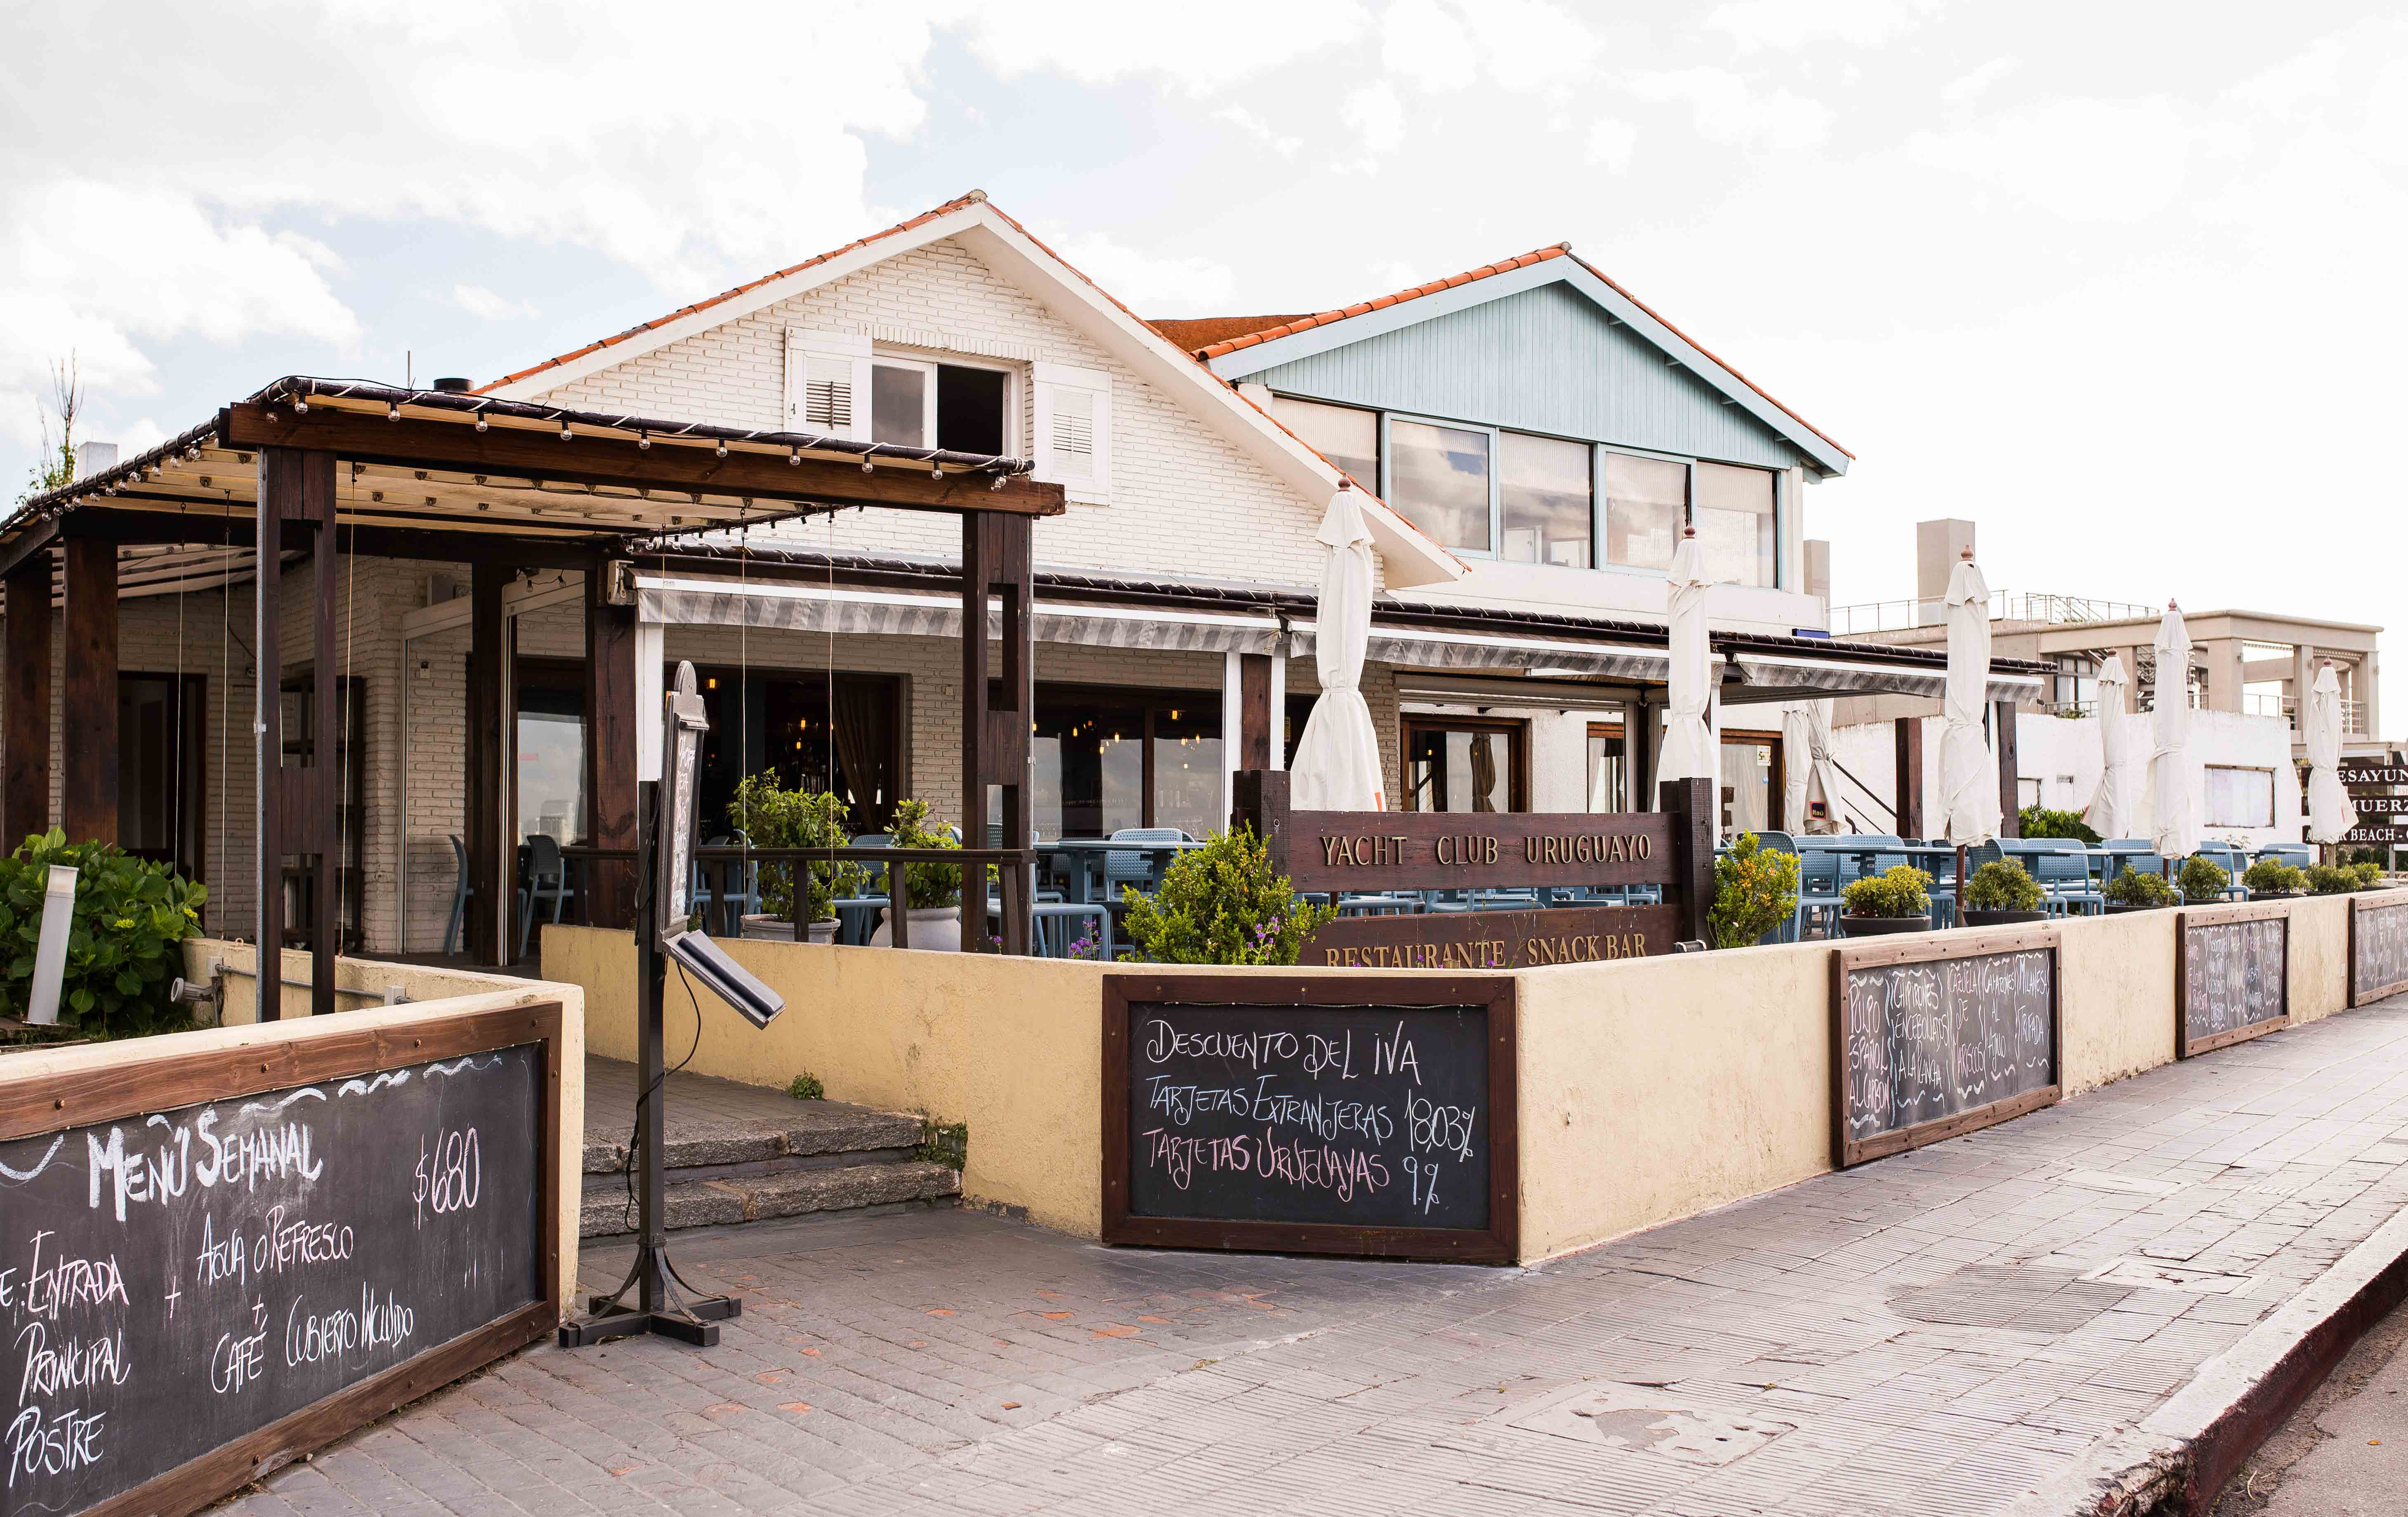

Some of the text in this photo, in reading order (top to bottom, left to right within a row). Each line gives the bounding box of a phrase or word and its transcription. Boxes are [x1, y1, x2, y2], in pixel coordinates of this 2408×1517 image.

[2337, 769, 2408, 782] ESAYUN
[1320, 833, 1652, 866] YACHT CLUB URUGUAYO
[2351, 829, 2395, 841] BEACH
[1325, 933, 1647, 969] RESTAURANTE SNACK BAR
[1894, 976, 1939, 1012] CHIPIRONES
[1949, 968, 1978, 996] CAZUELA
[1983, 962, 2014, 996] CAMARONES
[2016, 957, 2047, 999] MILANESA
[1848, 984, 1881, 1037] PULPO
[1895, 1011, 1948, 1052] ENCEBOLLADOS
[1956, 997, 1968, 1029] DE
[1992, 997, 2000, 1022] AL
[2017, 1005, 2045, 1045] TRUFADA
[1146, 1019, 1299, 1070] DESCUENTO
[1303, 1029, 1359, 1080] DEL
[1915, 1039, 1941, 1089] PLANCHA
[1988, 1026, 2006, 1072] AJILLO
[1146, 1074, 1476, 1163] TARJETAS EXTRANJERAS 18,03%
[87, 1105, 323, 1222] MENÚ SEMANAL
[413, 1126, 480, 1230] $680
[1142, 1127, 1250, 1191] TARJETAS
[1257, 1126, 1390, 1203] URUGUAYAS
[196, 1212, 246, 1286] AGUA
[266, 1205, 353, 1273] REFRESCO
[28, 1230, 130, 1321] ENTRADA
[286, 1281, 413, 1367] CUBIERTO INCLUIDO
[14, 1321, 131, 1408] PRINCIPAL
[211, 1313, 268, 1394] CAFÉ
[5, 1405, 107, 1489] POSTRE
